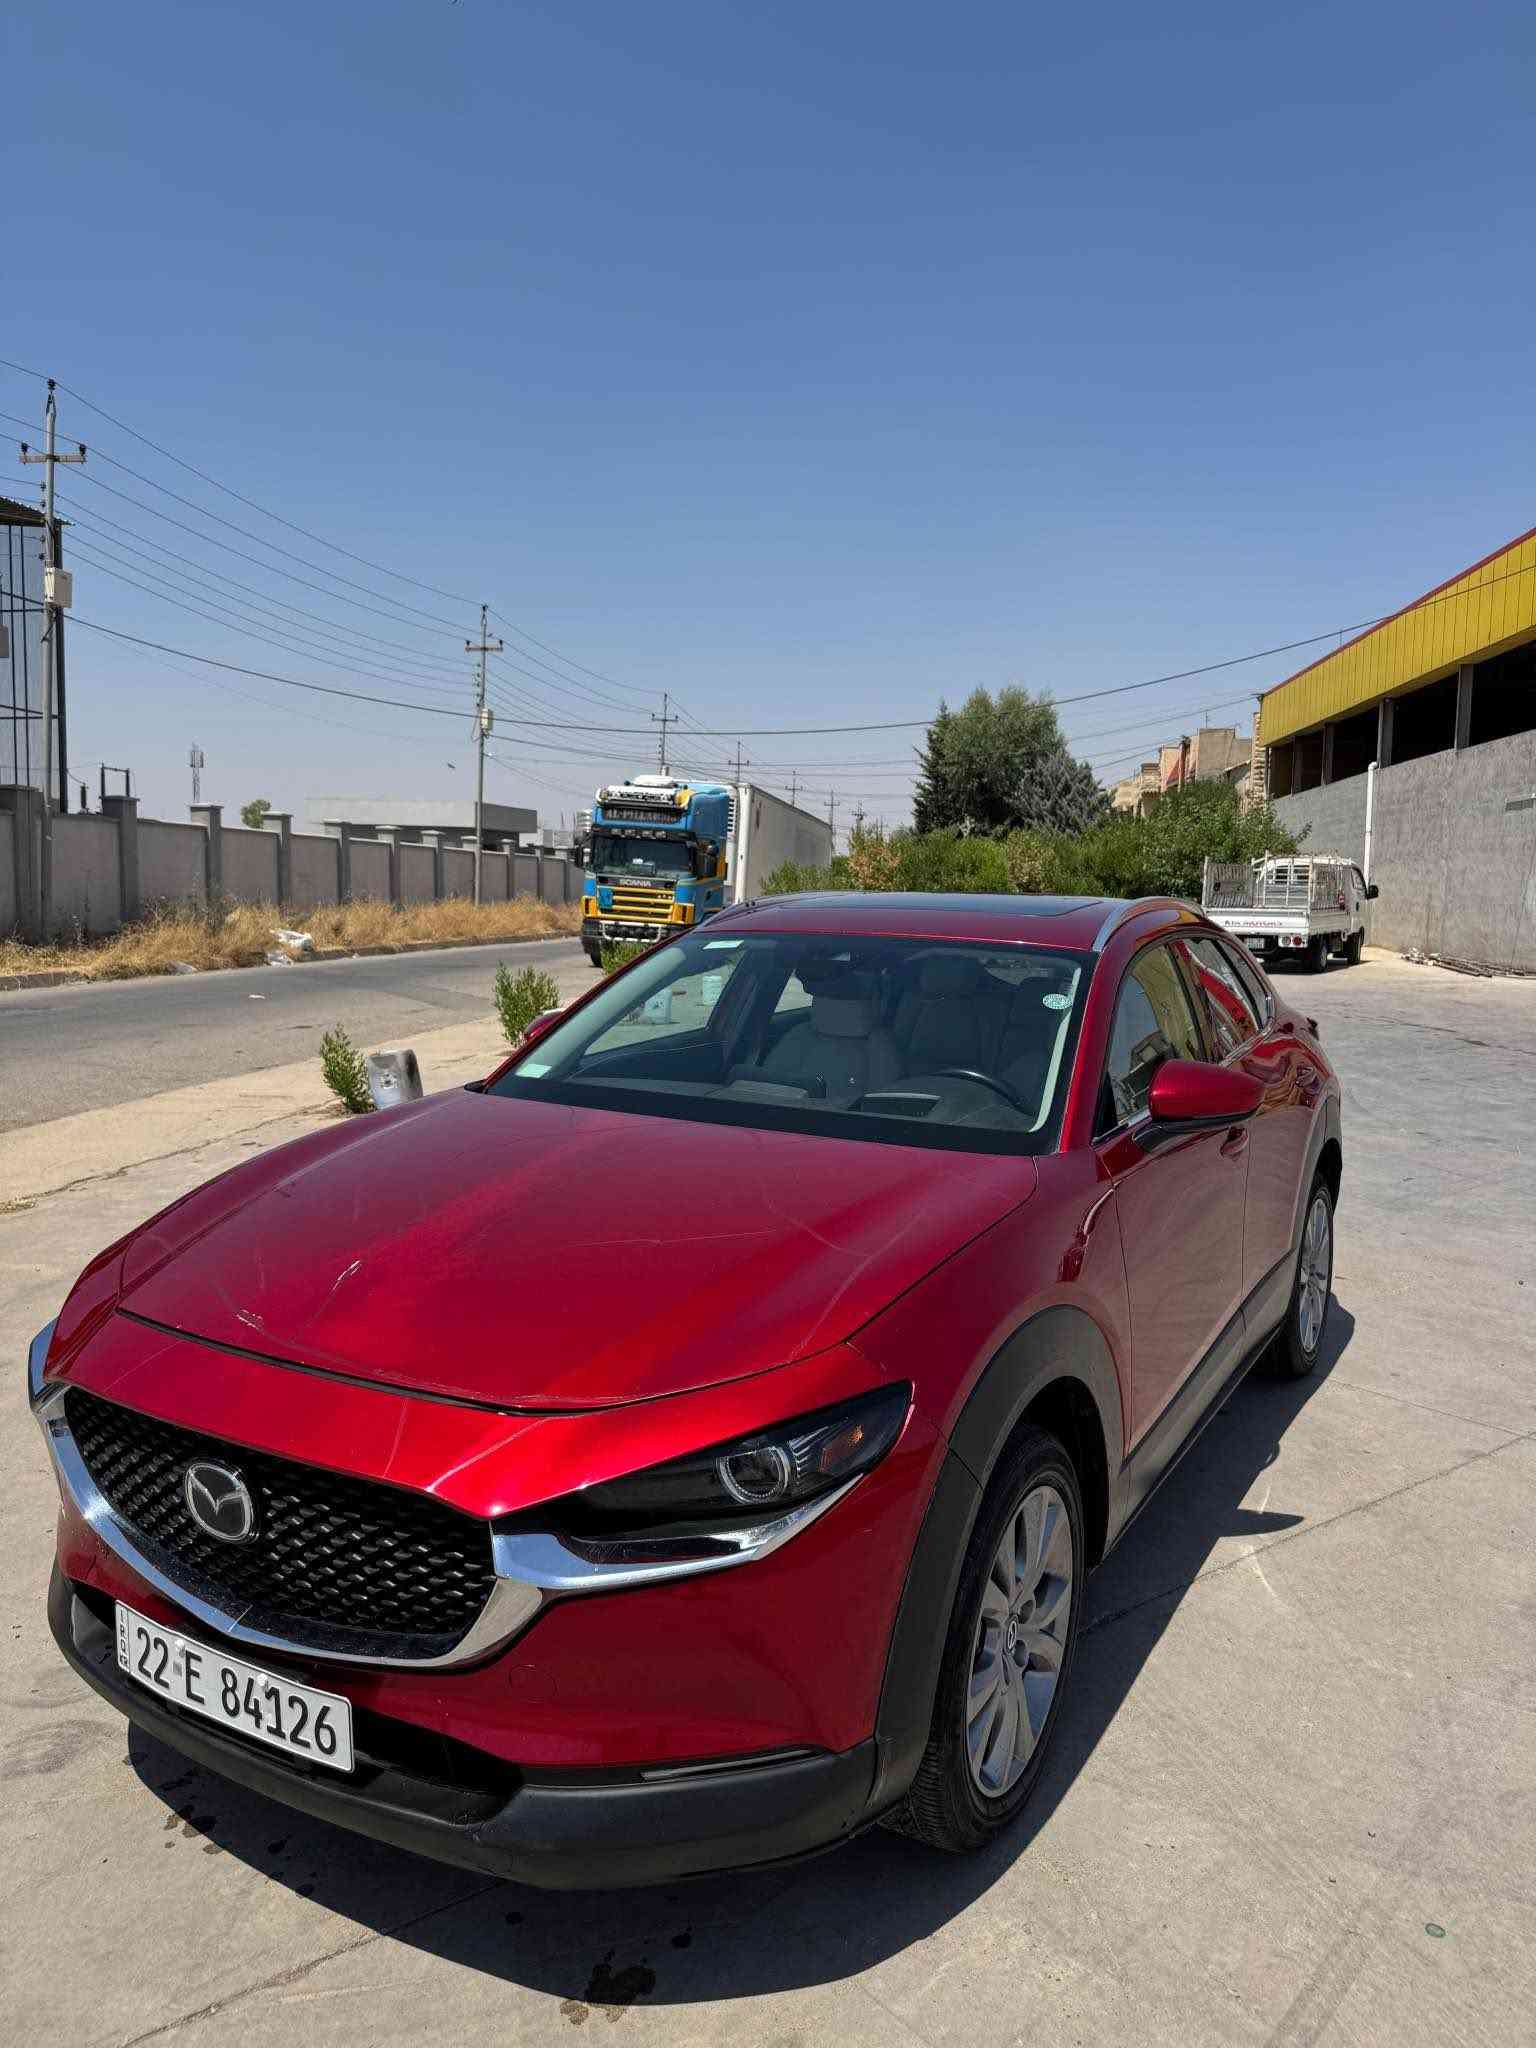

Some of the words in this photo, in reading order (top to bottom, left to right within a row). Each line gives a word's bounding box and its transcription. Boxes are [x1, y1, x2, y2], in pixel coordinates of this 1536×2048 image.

[137, 1627, 169, 1688] 22
[185, 1649, 205, 1705] E
[221, 1667, 337, 1756] 84126
